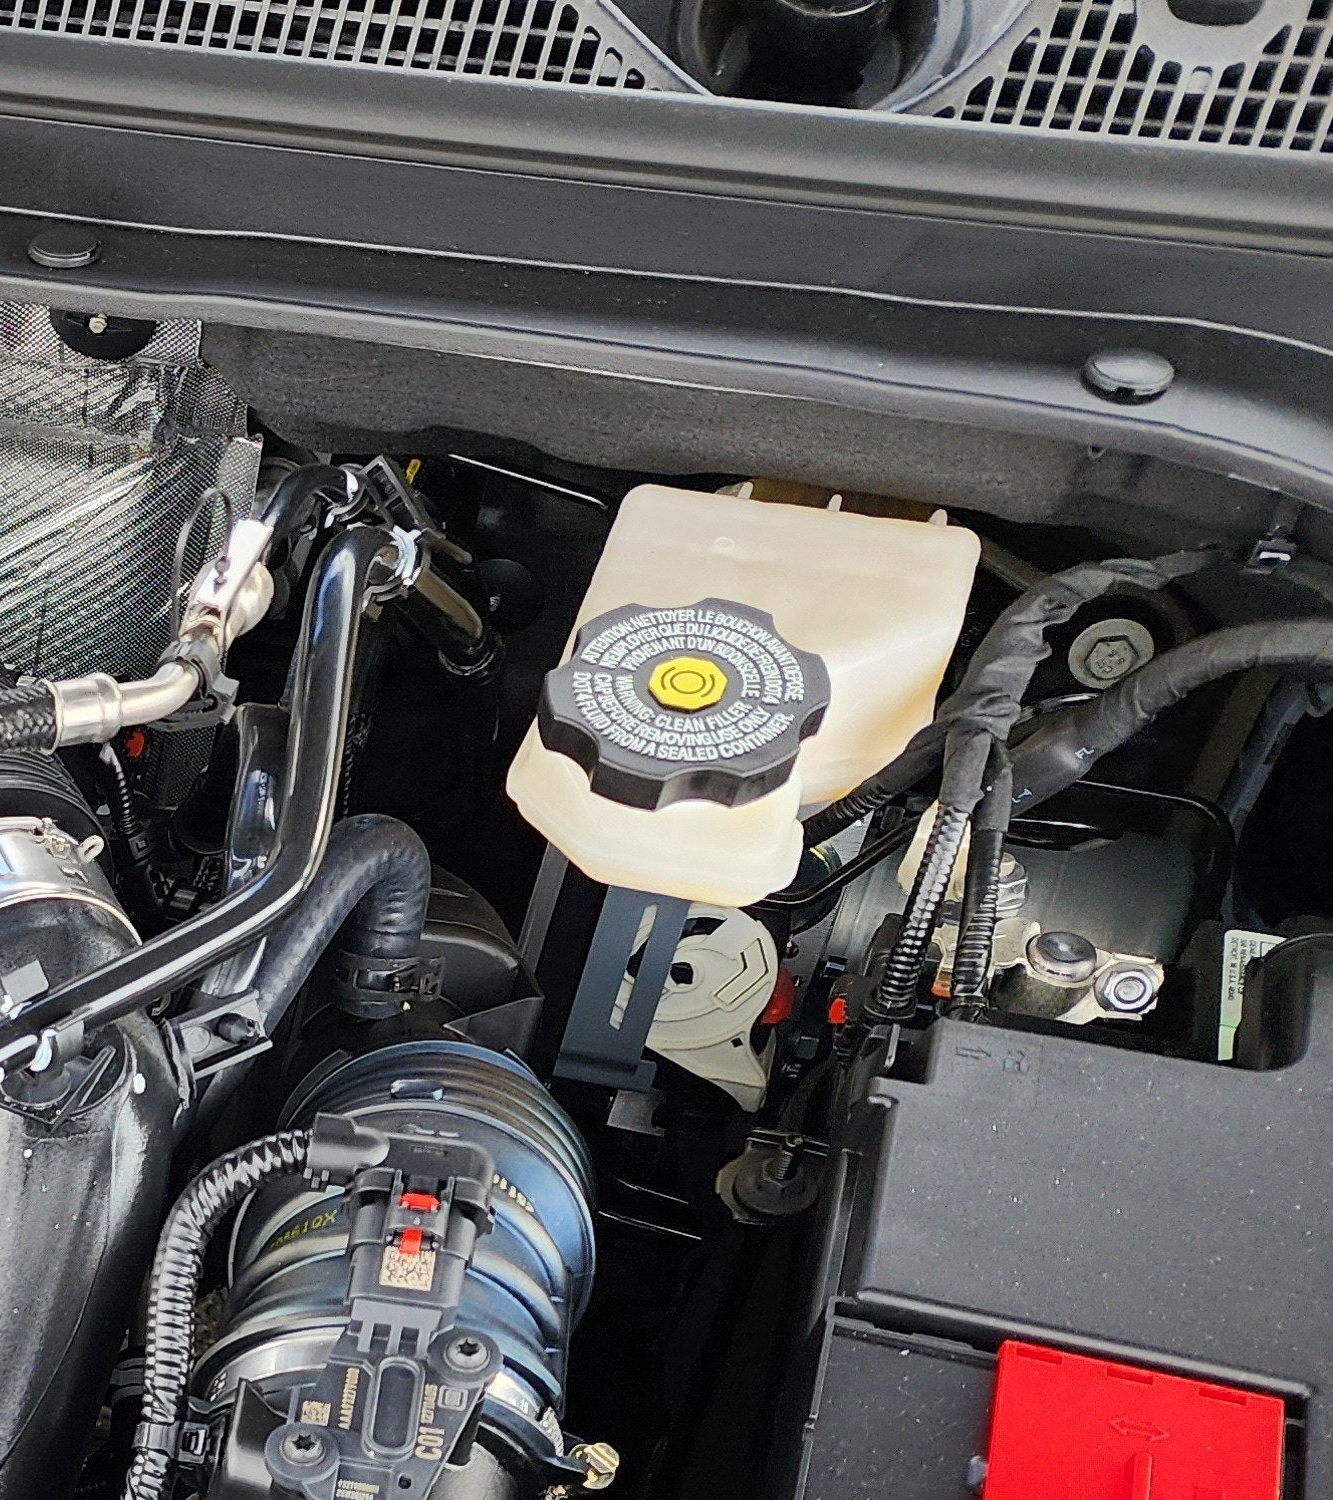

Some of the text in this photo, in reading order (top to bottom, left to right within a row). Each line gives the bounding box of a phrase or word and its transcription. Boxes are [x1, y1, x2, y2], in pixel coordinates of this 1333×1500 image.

[629, 608, 696, 630] NETTOYER
[697, 608, 716, 624] LE
[658, 621, 687, 638] QUE
[686, 622, 704, 637] DU
[594, 672, 613, 695] CAP
[598, 693, 641, 732] BEFORE
[654, 713, 706, 732] CLEAN
[705, 700, 753, 731] FILLER
[737, 704, 772, 734] ONLY
[640, 741, 657, 757] A
[656, 743, 719, 762] SEALED
